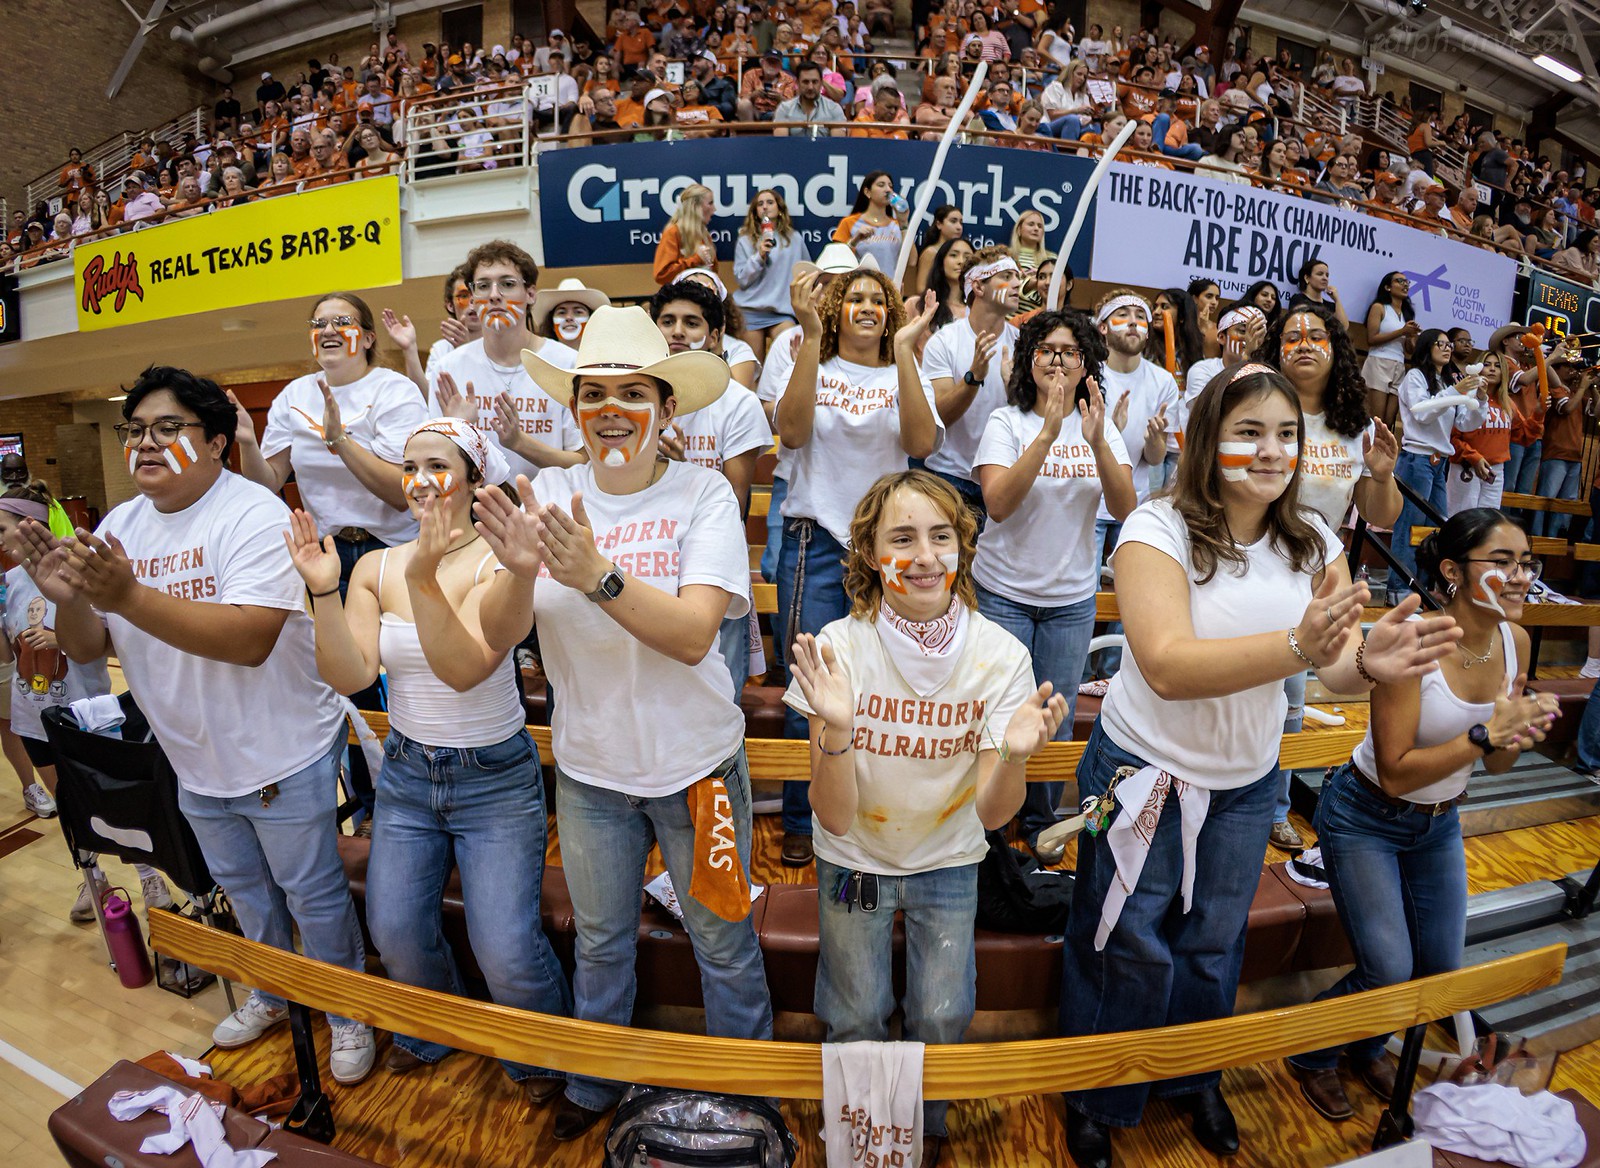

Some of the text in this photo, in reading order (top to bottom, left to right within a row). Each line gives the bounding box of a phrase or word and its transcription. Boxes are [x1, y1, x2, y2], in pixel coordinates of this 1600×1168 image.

[535, 84, 548, 96] 31
[1109, 171, 1394, 259] THE BACK-TO-BACK CHAMPIONS...
[1183, 219, 1243, 274] ARE
[82, 250, 144, 314] Rudy's
[150, 253, 200, 284] REAL
[202, 238, 273, 274] TEXAS
[1452, 296, 1486, 314] AUSTIN
[1540, 283, 1579, 313] TEXAS
[855, 692, 988, 728] LONGHORN
[853, 726, 982, 760] ELLRAISER
[708, 781, 735, 873] EXAS
